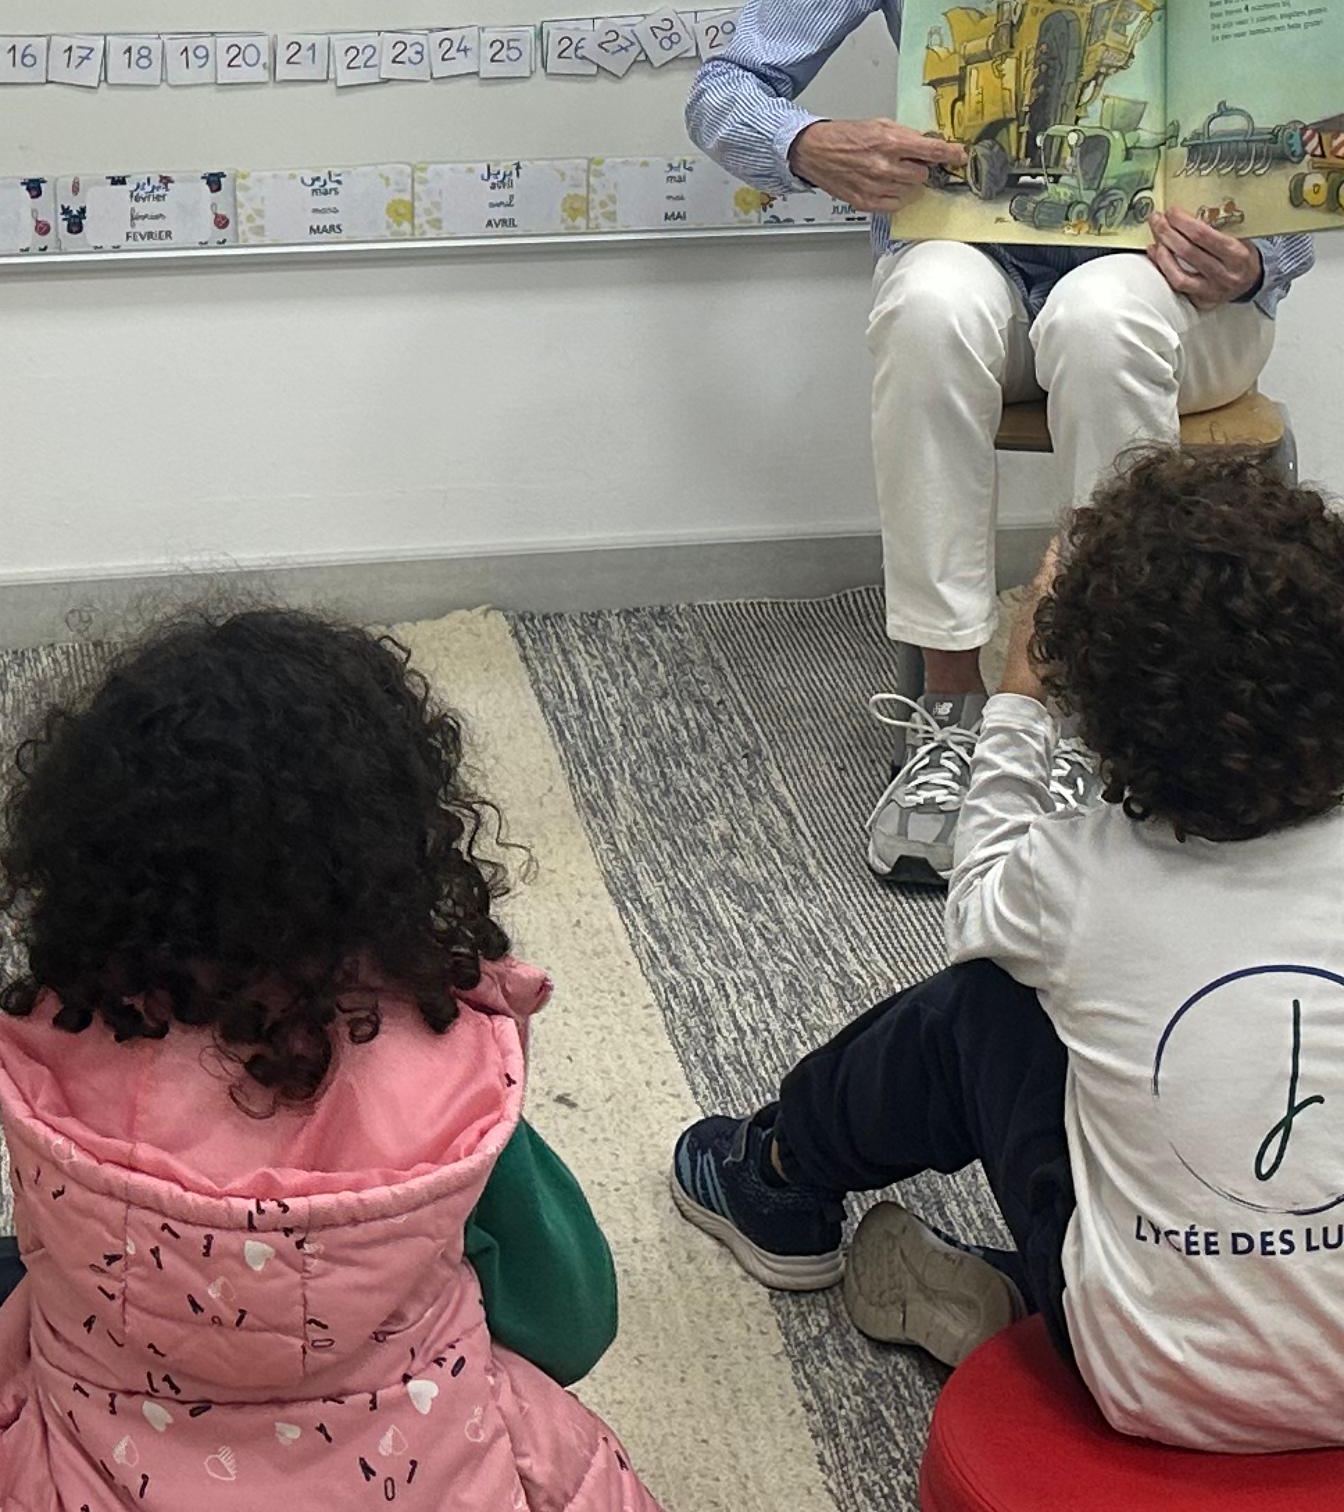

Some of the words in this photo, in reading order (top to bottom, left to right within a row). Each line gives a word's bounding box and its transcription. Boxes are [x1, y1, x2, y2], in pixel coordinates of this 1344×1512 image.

[6, 43, 37, 69] 16
[62, 44, 94, 69] 17
[123, 44, 153, 70] 18
[179, 44, 210, 68] 19
[226, 43, 261, 69] 20
[285, 41, 317, 66] 21
[345, 44, 378, 70] 22
[391, 41, 425, 66] 23
[438, 35, 472, 61] 24
[488, 39, 523, 64] 25
[650, 17, 682, 52] 28
[664, 212, 687, 222] MAI
[486, 218, 518, 228] AVRIL
[309, 224, 343, 235] MARS
[126, 230, 173, 241] FEVRIER
[1135, 1215, 1220, 1256] LYCÉE
[1230, 1228, 1295, 1257] DES
